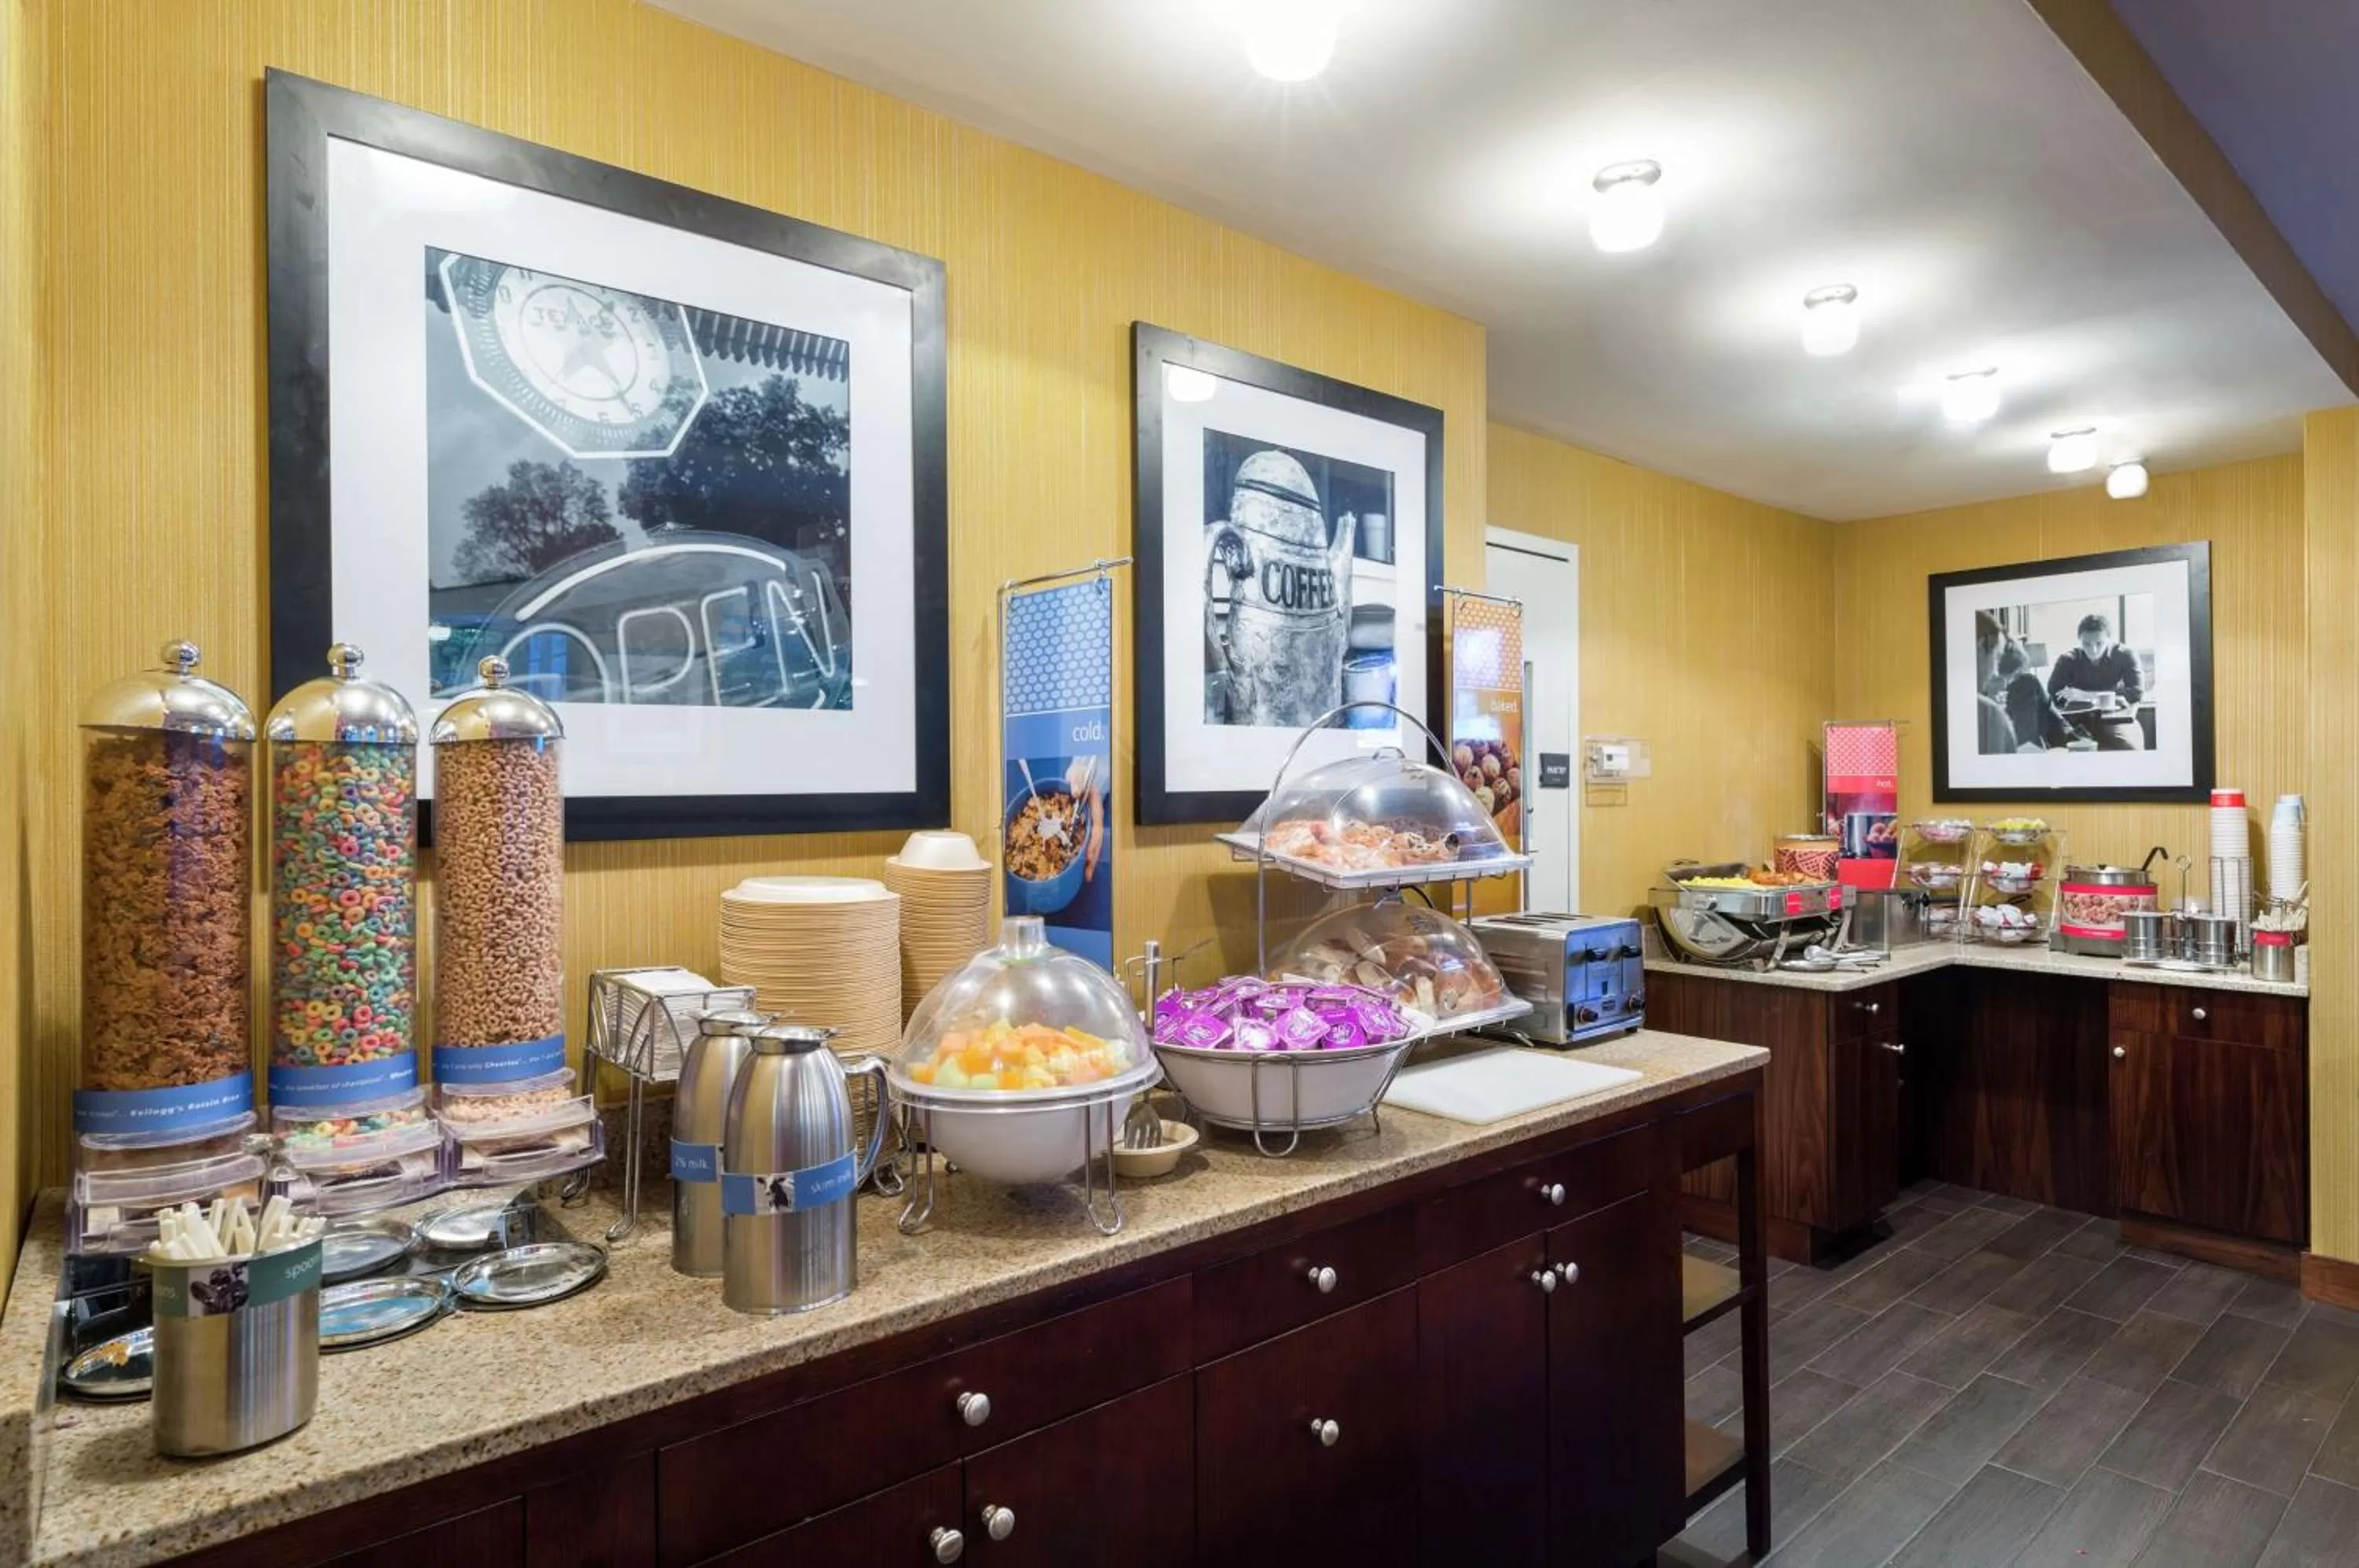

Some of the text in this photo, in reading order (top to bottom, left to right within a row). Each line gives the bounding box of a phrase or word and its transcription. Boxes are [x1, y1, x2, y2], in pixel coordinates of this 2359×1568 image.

[1260, 559, 1335, 610] COFFEE
[500, 569, 836, 706] OPEN
[1072, 720, 1105, 742] cold.
